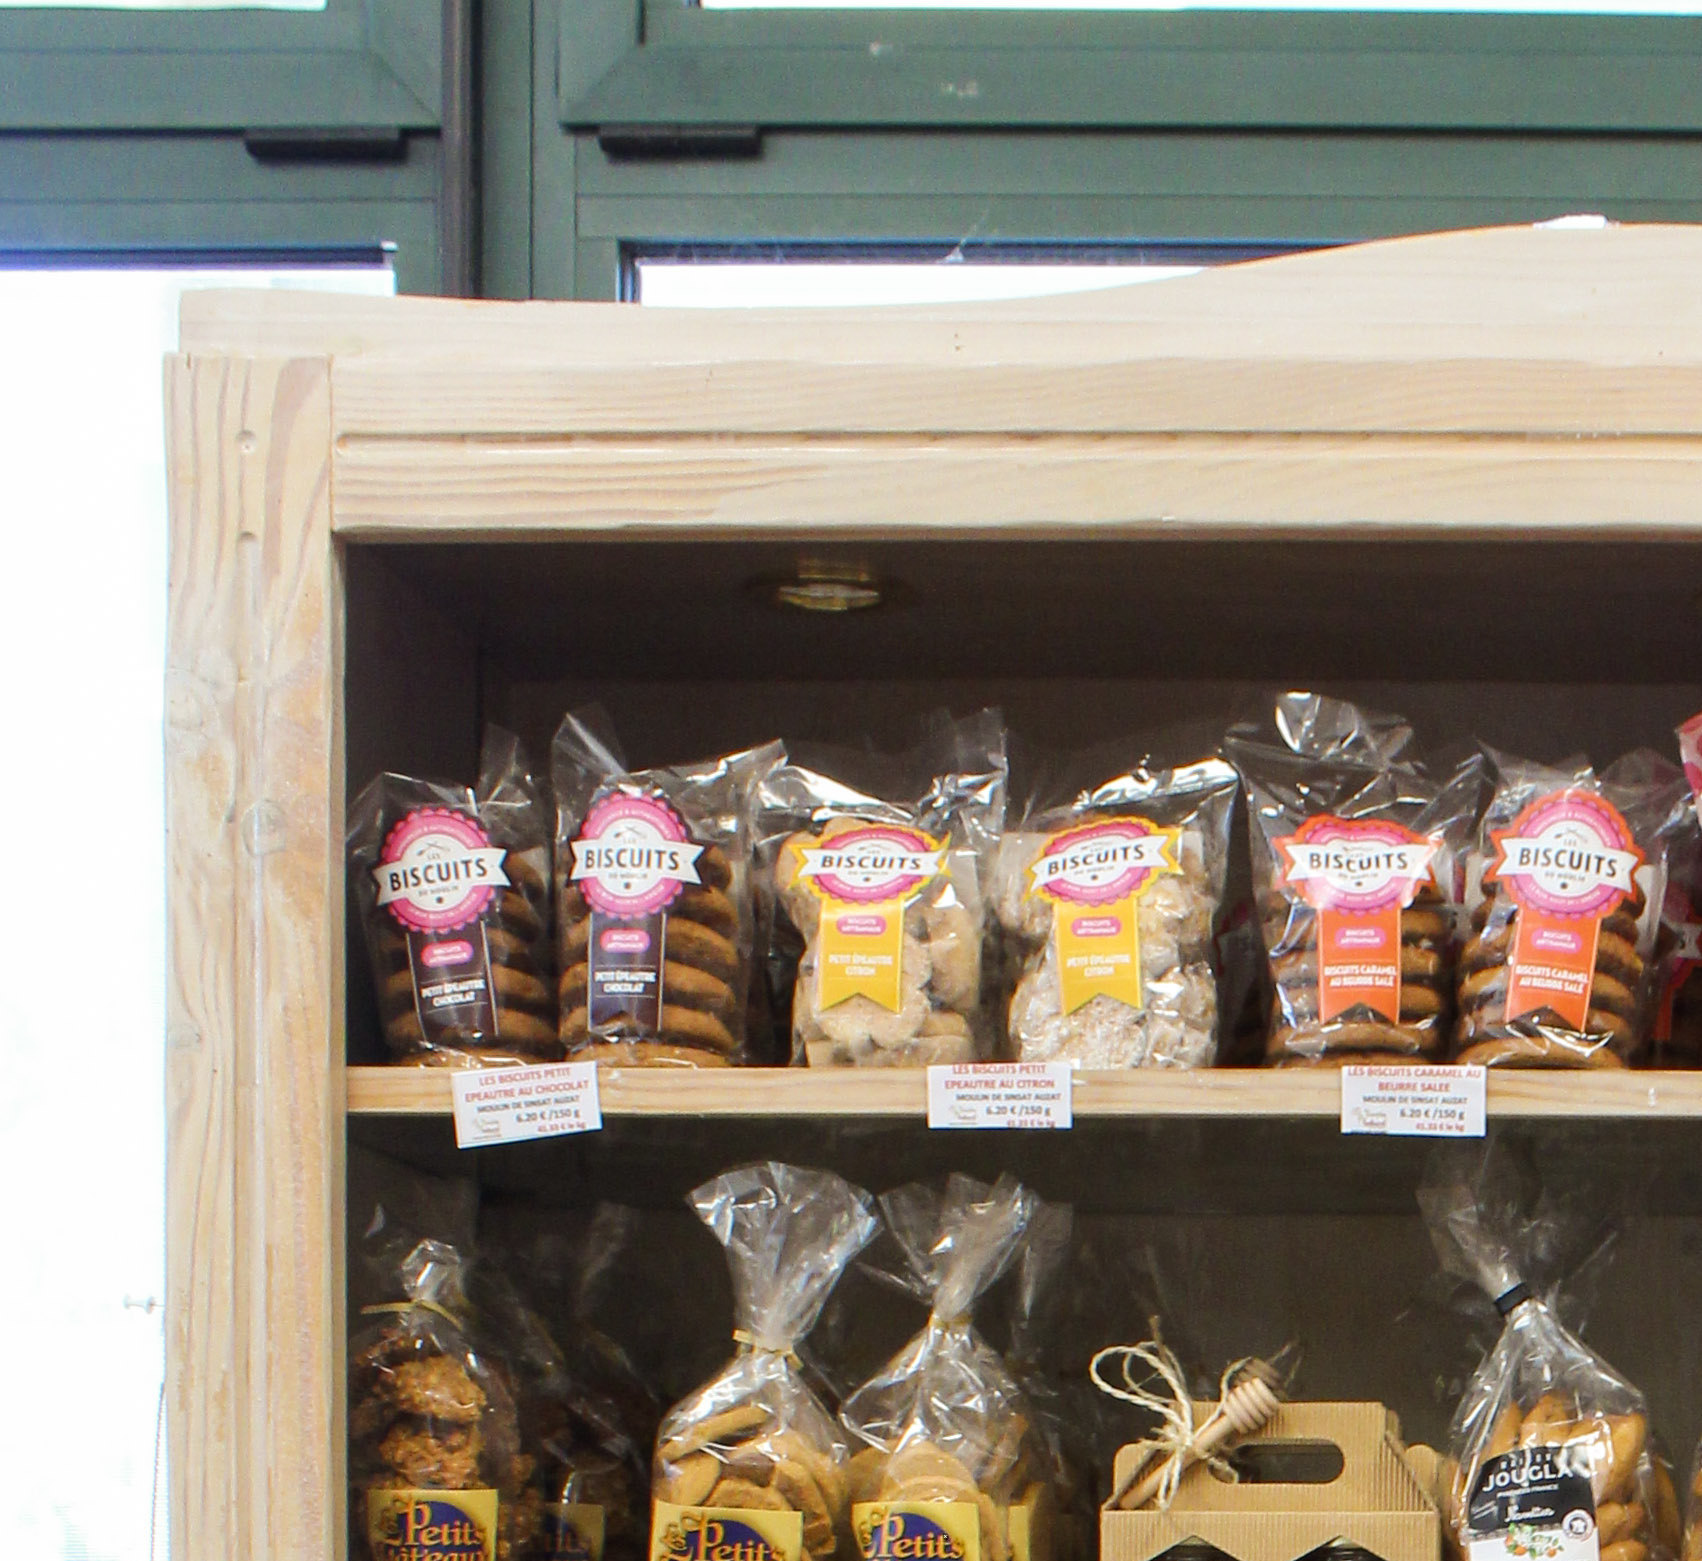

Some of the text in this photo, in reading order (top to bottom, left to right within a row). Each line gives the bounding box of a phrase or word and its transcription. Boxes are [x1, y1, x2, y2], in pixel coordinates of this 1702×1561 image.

[390, 858, 487, 891] BISCUITS
[585, 849, 679, 870] BISCUITS
[820, 855, 922, 870] BISCUITS
[1047, 845, 1145, 876] BISCUITS
[1310, 852, 1408, 873] BISCUITS
[1518, 847, 1617, 877] BISCUITS
[1482, 1465, 1573, 1492] JOUGLA
[384, 1496, 486, 1546] Petits
[864, 1504, 965, 1559] Petits
